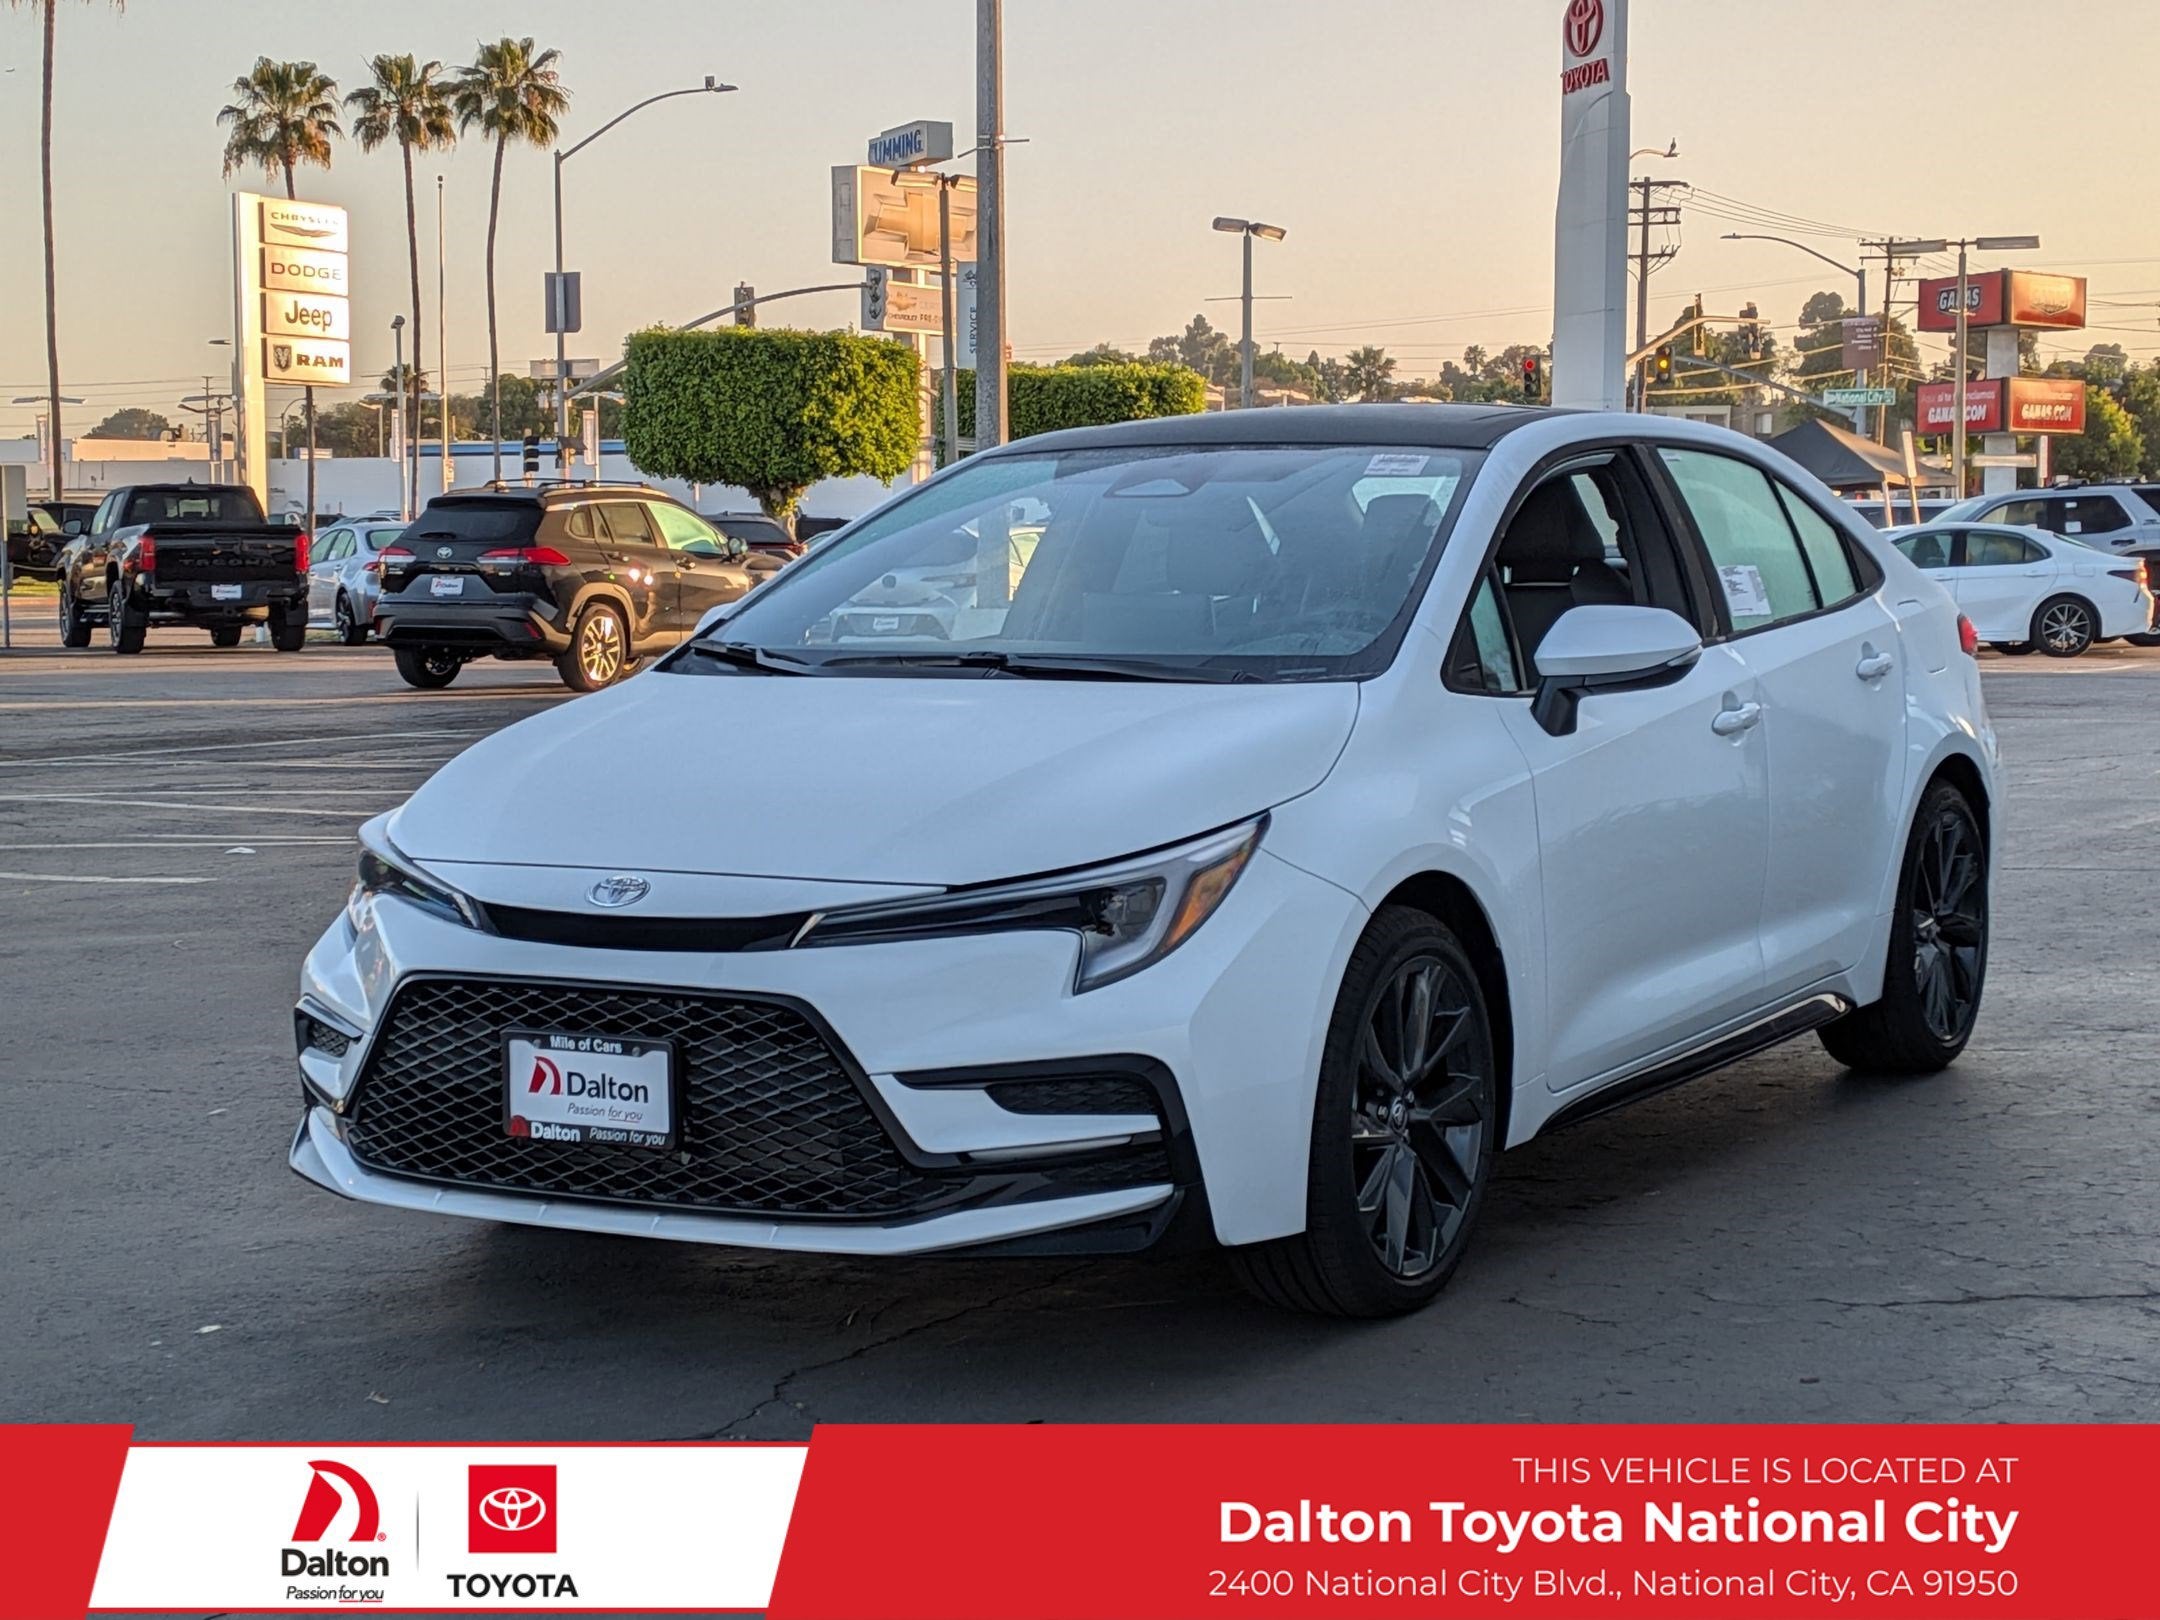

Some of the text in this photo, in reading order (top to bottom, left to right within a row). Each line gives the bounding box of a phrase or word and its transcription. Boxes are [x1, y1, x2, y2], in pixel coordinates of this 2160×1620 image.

[271, 262, 342, 281] DODGE
[1939, 288, 1980, 310] GAAS
[285, 300, 333, 333] Jeep
[296, 353, 344, 369] RAM
[1928, 404, 1987, 423] GANACOM
[549, 1035, 623, 1054] Mile of Cars
[567, 1071, 649, 1104] Dalton
[567, 1102, 644, 1121] Passion for you
[530, 1121, 581, 1143] Dalton
[589, 1126, 666, 1147] Passion for you
